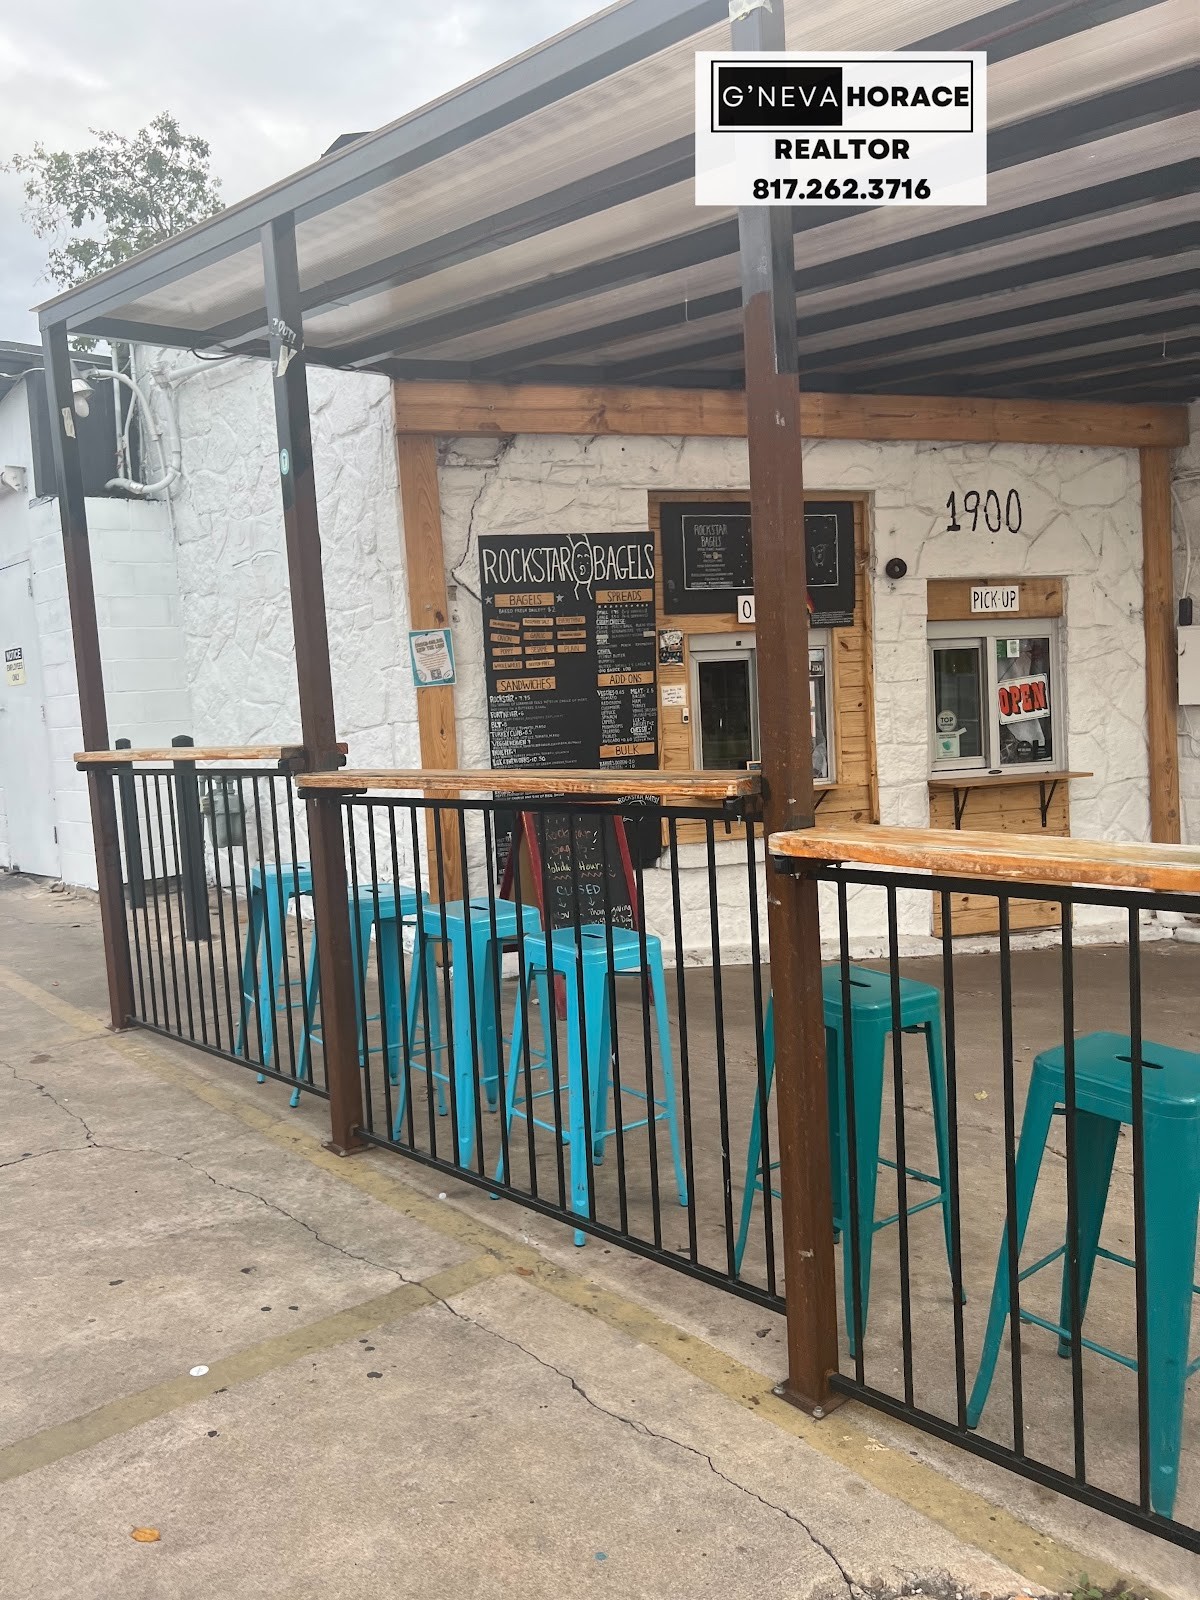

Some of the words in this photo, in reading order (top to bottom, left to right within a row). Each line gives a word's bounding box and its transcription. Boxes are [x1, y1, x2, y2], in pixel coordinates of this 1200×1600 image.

[946, 488, 1022, 533] 1900
[482, 546, 573, 584] ROCKSTAR
[594, 544, 655, 581] BAGELS
[509, 594, 542, 606] BAGELS
[607, 590, 642, 602] SPREADS
[973, 589, 1016, 610] PICK-UP
[500, 680, 552, 691] SANDWICHES
[998, 681, 1048, 716] OPEN
[615, 744, 639, 756] BULK
